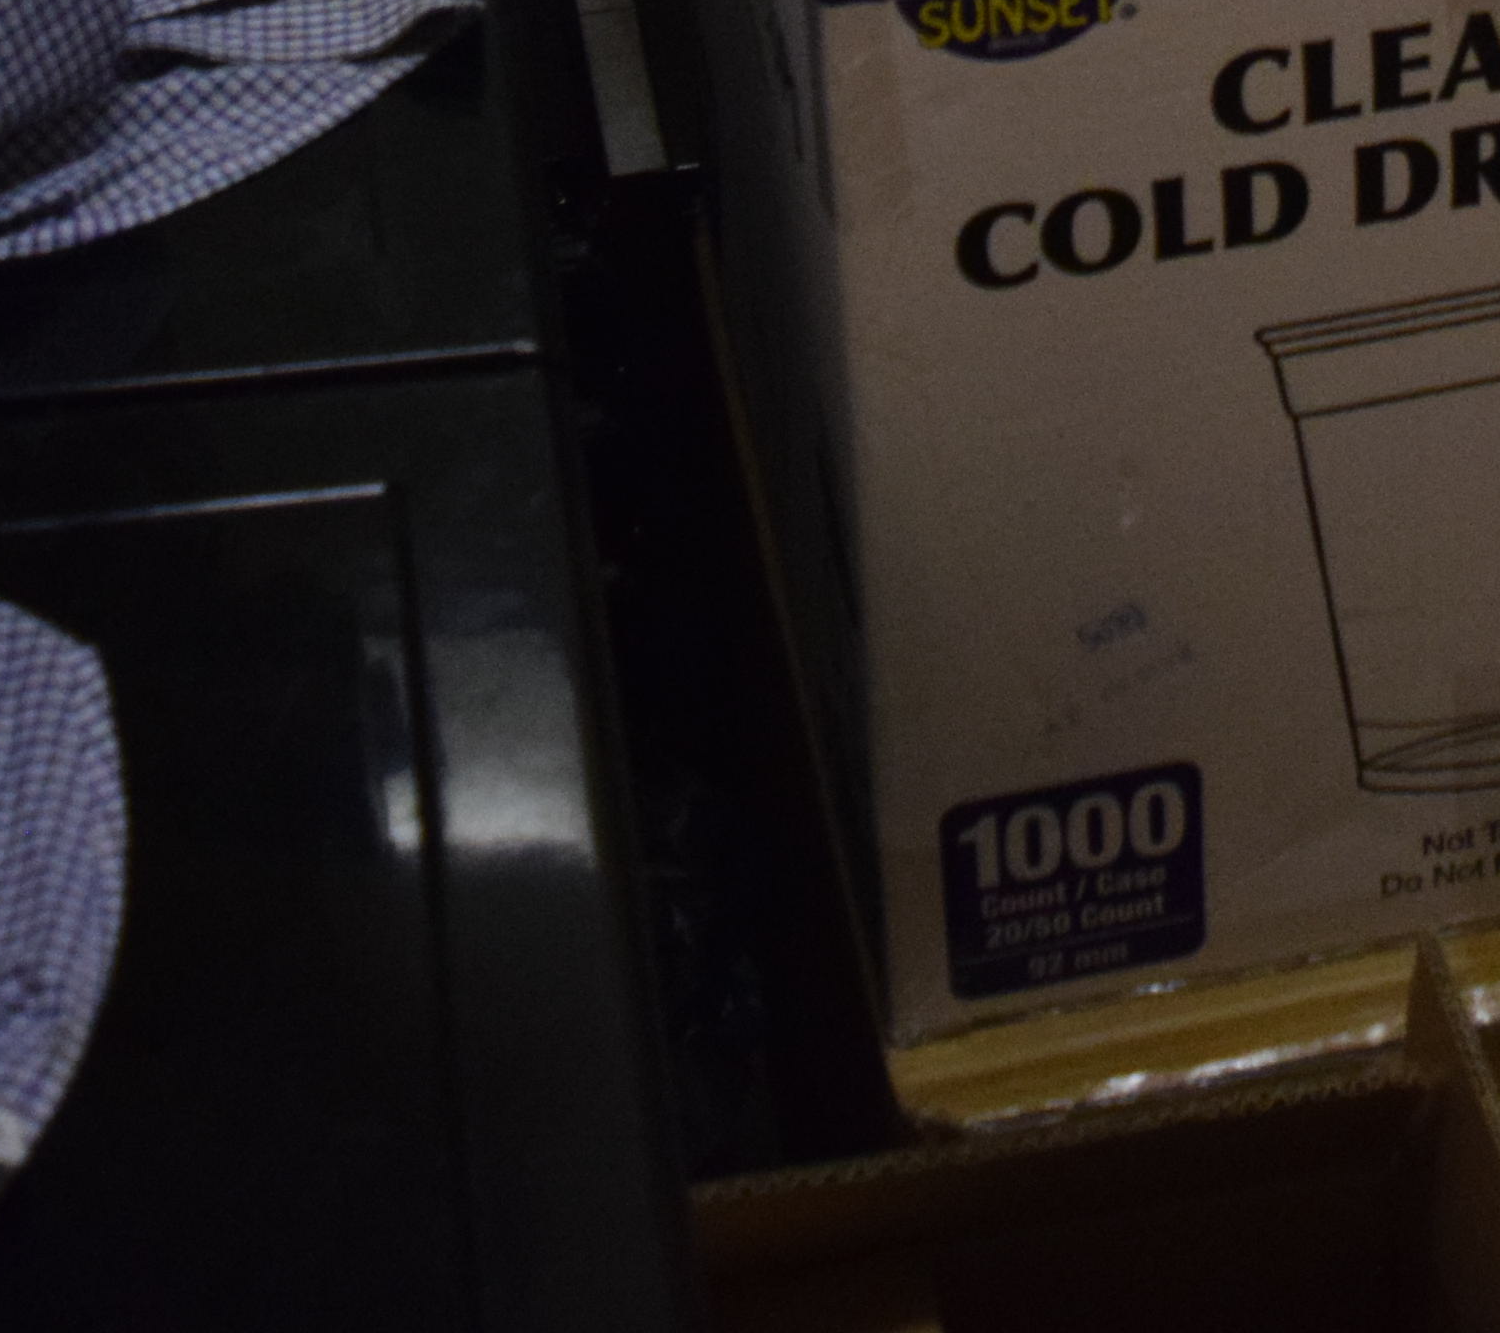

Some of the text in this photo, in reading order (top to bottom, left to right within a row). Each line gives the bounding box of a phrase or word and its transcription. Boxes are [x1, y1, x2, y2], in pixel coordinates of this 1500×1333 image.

[952, 157, 1312, 289] COLD
[956, 780, 1187, 892] 1000
[1421, 827, 1476, 857] Not
[980, 880, 1068, 920] Count
[1094, 864, 1167, 897] Case
[1379, 868, 1424, 900] Do
[1431, 853, 1486, 884] Not
[1079, 893, 1166, 931] Count
